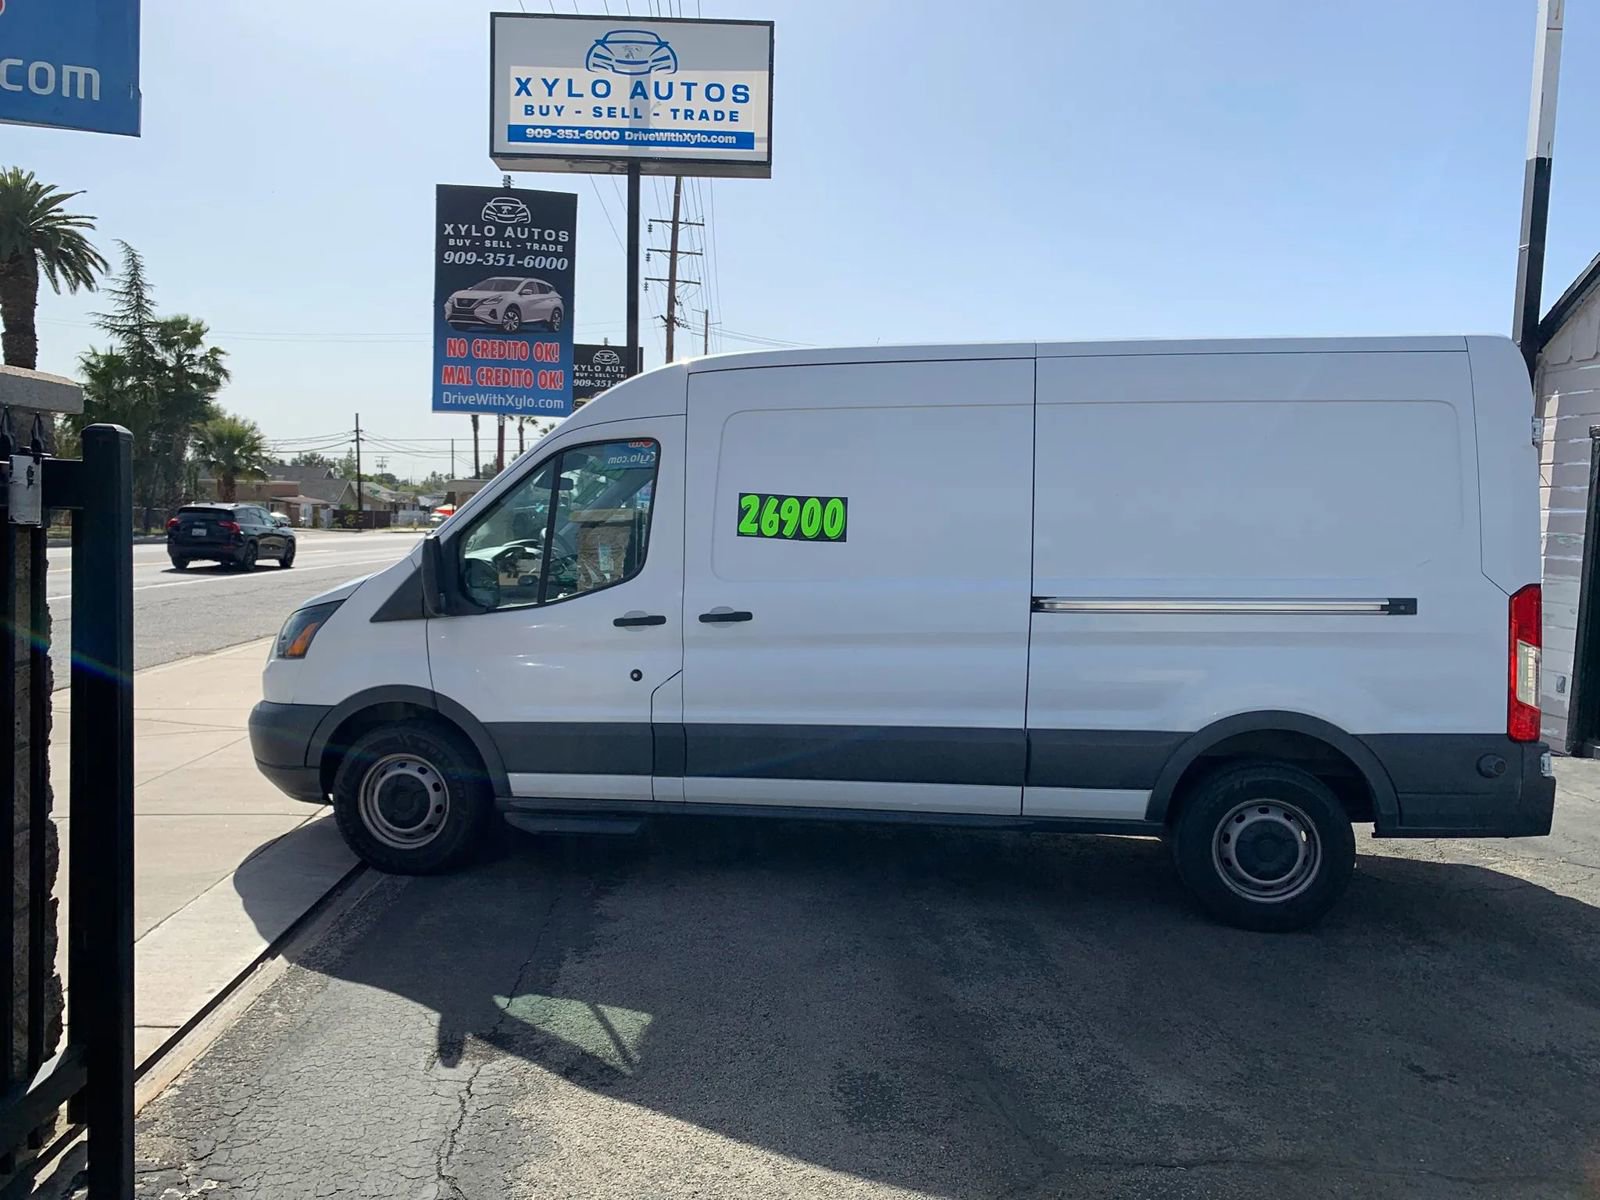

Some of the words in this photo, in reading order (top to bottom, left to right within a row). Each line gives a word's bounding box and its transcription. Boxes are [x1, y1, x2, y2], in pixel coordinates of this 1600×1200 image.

[514, 77, 612, 98] XYLO
[629, 80, 750, 104] AUTOS
[524, 104, 565, 117] BUY
[592, 106, 643, 119] SELL
[670, 108, 740, 122] TRADE
[525, 128, 620, 141] 909-351-6000
[624, 131, 737, 145] DriveWithXylo.com
[443, 223, 496, 237] XYLO
[504, 226, 570, 242] AUTOS
[448, 238, 471, 247] BUY
[484, 240, 512, 249] SELL
[526, 242, 564, 253] TRADE
[443, 250, 569, 271] 909-351-6000
[446, 337, 468, 359] NO
[471, 338, 530, 361] CREDITO
[533, 341, 560, 364] OK!
[441, 364, 473, 386] MAL
[476, 366, 534, 390] CREDITO
[538, 369, 564, 391] OK!
[573, 364, 601, 372] XYLO
[442, 391, 565, 410] DriveWithXylo.com
[738, 494, 846, 539] 26900
